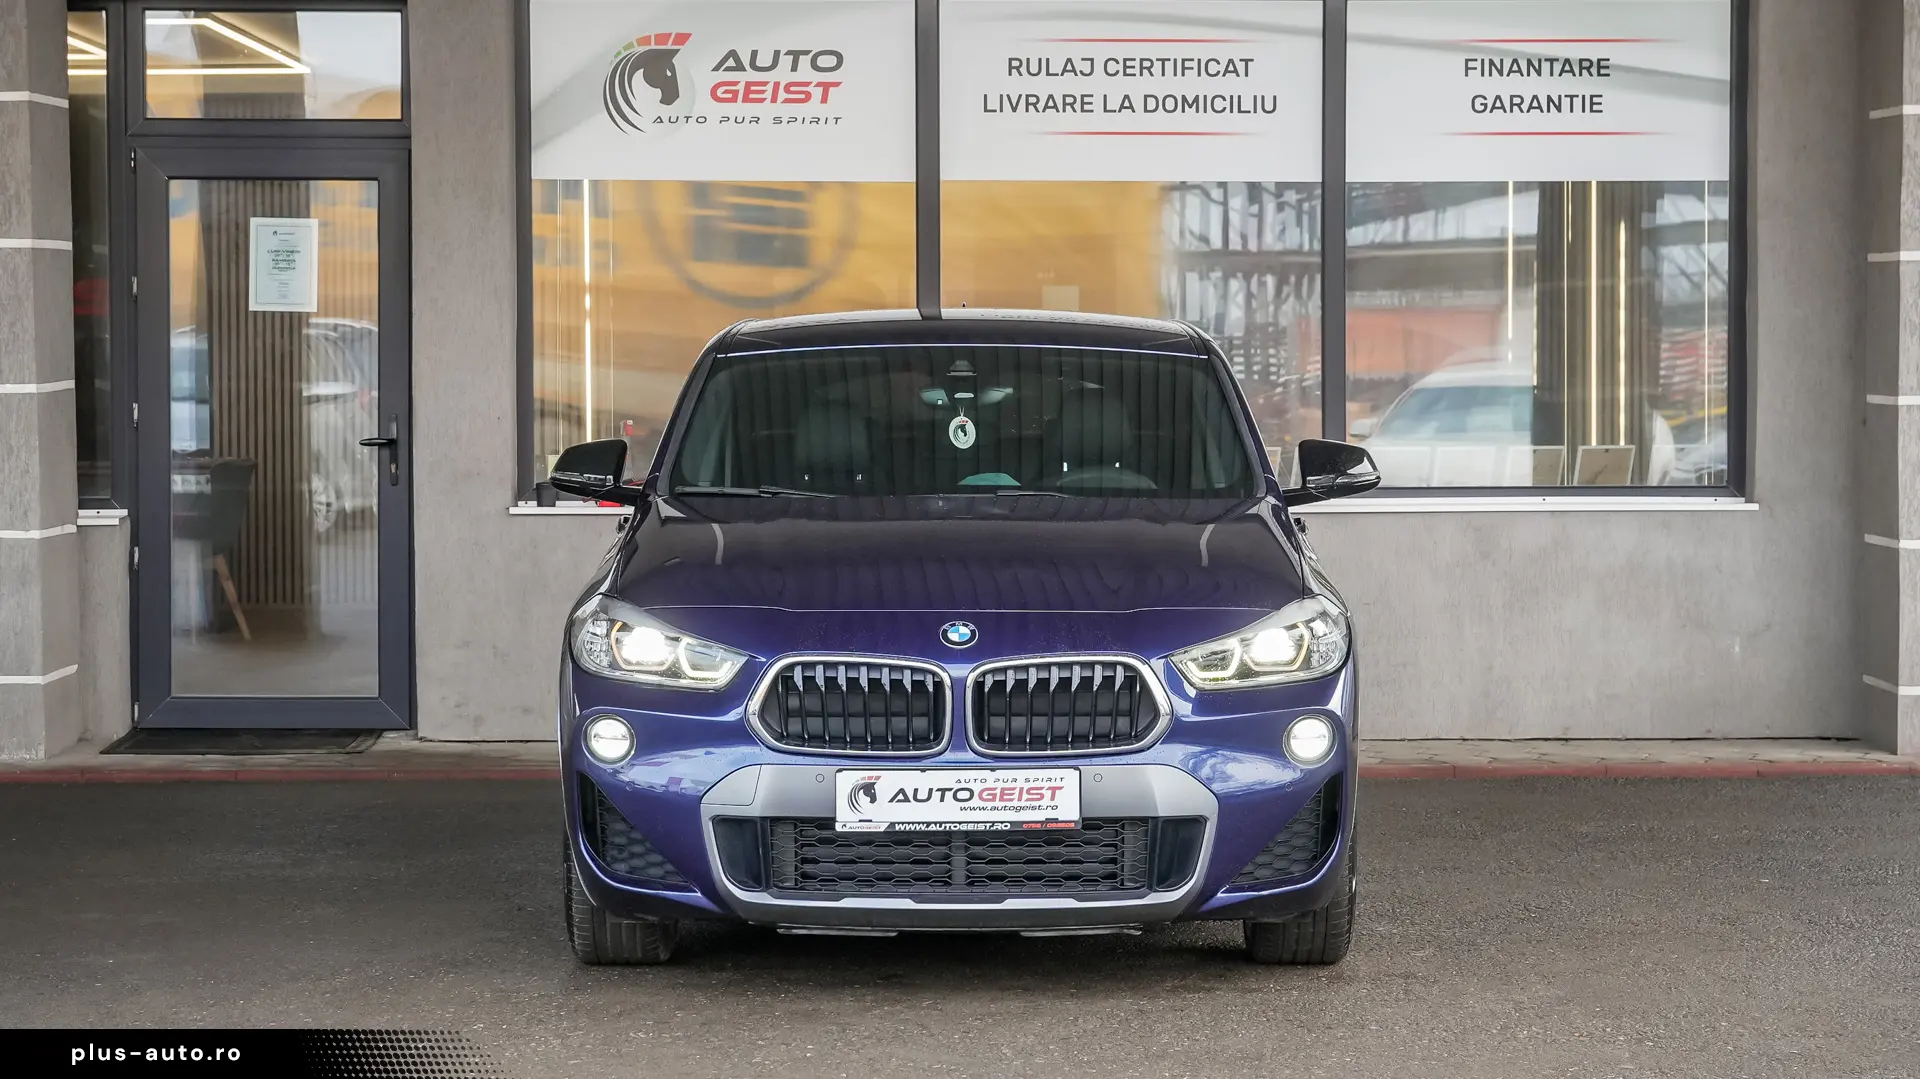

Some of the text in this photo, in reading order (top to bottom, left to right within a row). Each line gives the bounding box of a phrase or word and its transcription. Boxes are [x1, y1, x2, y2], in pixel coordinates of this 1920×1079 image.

[710, 48, 844, 73] AUTO
[1007, 57, 1255, 78] RULAJ CERTIFICAT
[1464, 57, 1611, 78] FINANTARE
[709, 80, 844, 105] GEIST
[983, 93, 1278, 115] LIVRARE LA DOMICILIU
[1471, 94, 1604, 114] GARANTIE
[652, 115, 842, 125] AUTO PUR SPIRIT
[887, 786, 1065, 803] AUTOGEIST
[959, 803, 1059, 813] www.autogeist.ro
[895, 822, 1011, 831] WWW.AUTOGEIST.RO
